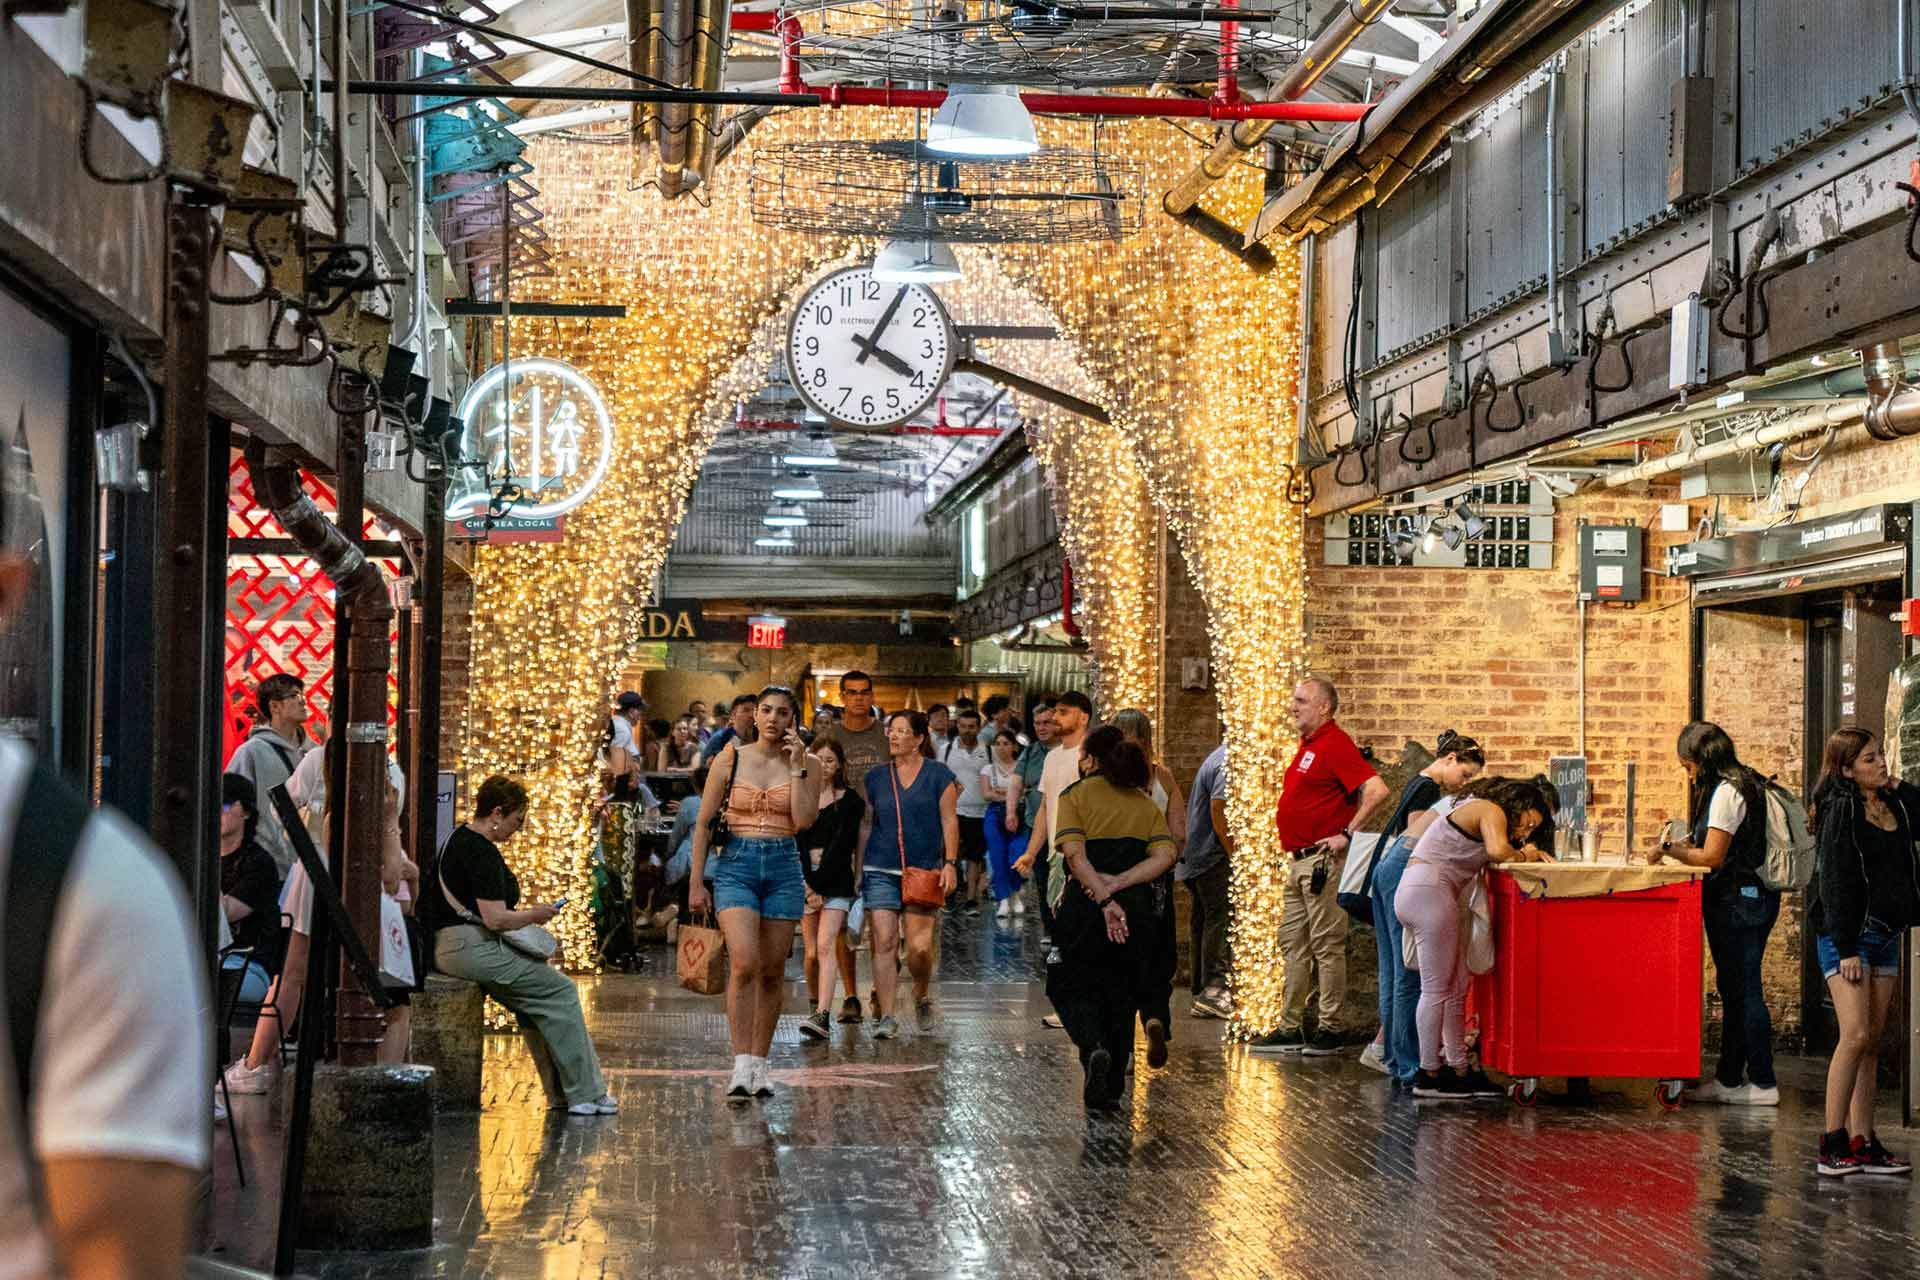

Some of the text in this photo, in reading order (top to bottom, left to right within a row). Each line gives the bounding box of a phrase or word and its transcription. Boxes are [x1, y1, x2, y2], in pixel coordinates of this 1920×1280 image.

[840, 286, 851, 307] 11
[862, 280, 881, 301] 12
[815, 305, 833, 325] 10
[912, 307, 926, 328] 2
[805, 336, 819, 356] 9
[920, 338, 934, 359] 3
[813, 367, 827, 388] 8
[909, 370, 925, 390] 4
[838, 387, 852, 408] 7
[861, 395, 875, 416] 6
[886, 388, 900, 409] 5
[518, 519, 552, 527] LOCAL
[752, 623, 778, 647] EXIT
